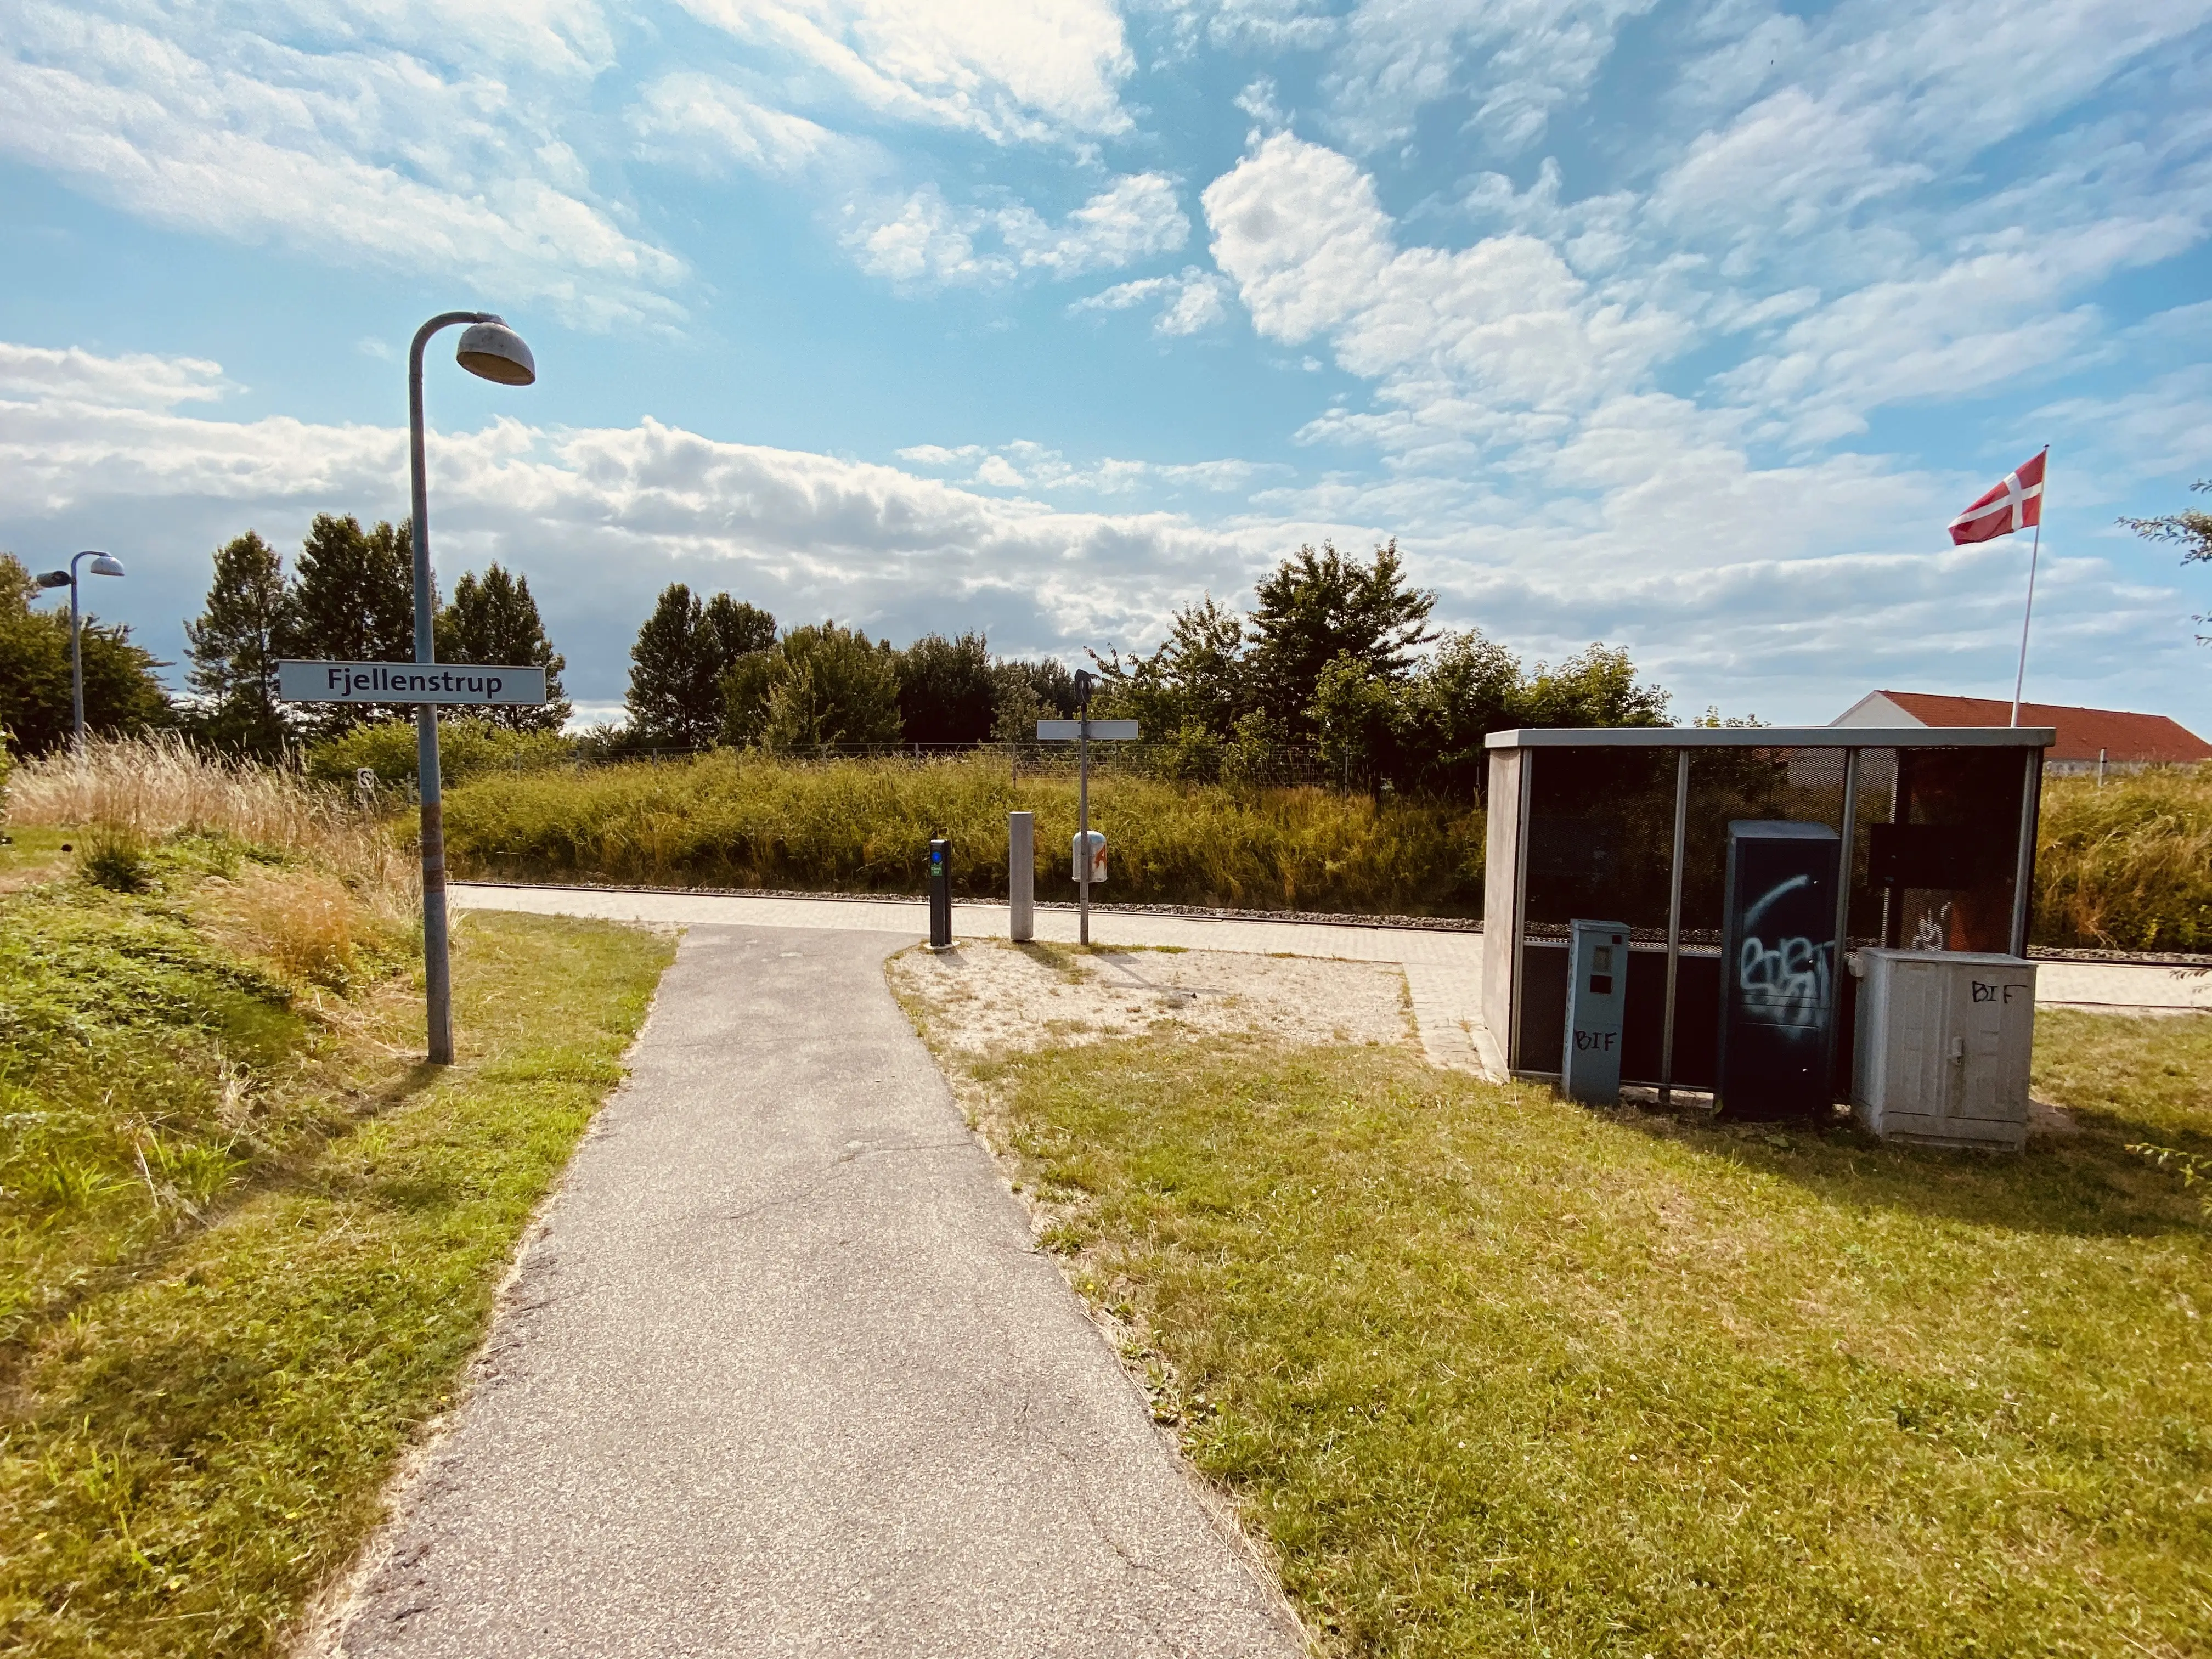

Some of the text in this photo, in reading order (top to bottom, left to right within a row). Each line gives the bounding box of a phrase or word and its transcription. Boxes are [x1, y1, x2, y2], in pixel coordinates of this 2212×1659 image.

[328, 667, 503, 698] Fjellenstrup
[1972, 980, 2028, 1003] BIF
[1575, 1030, 1617, 1051] BIF
